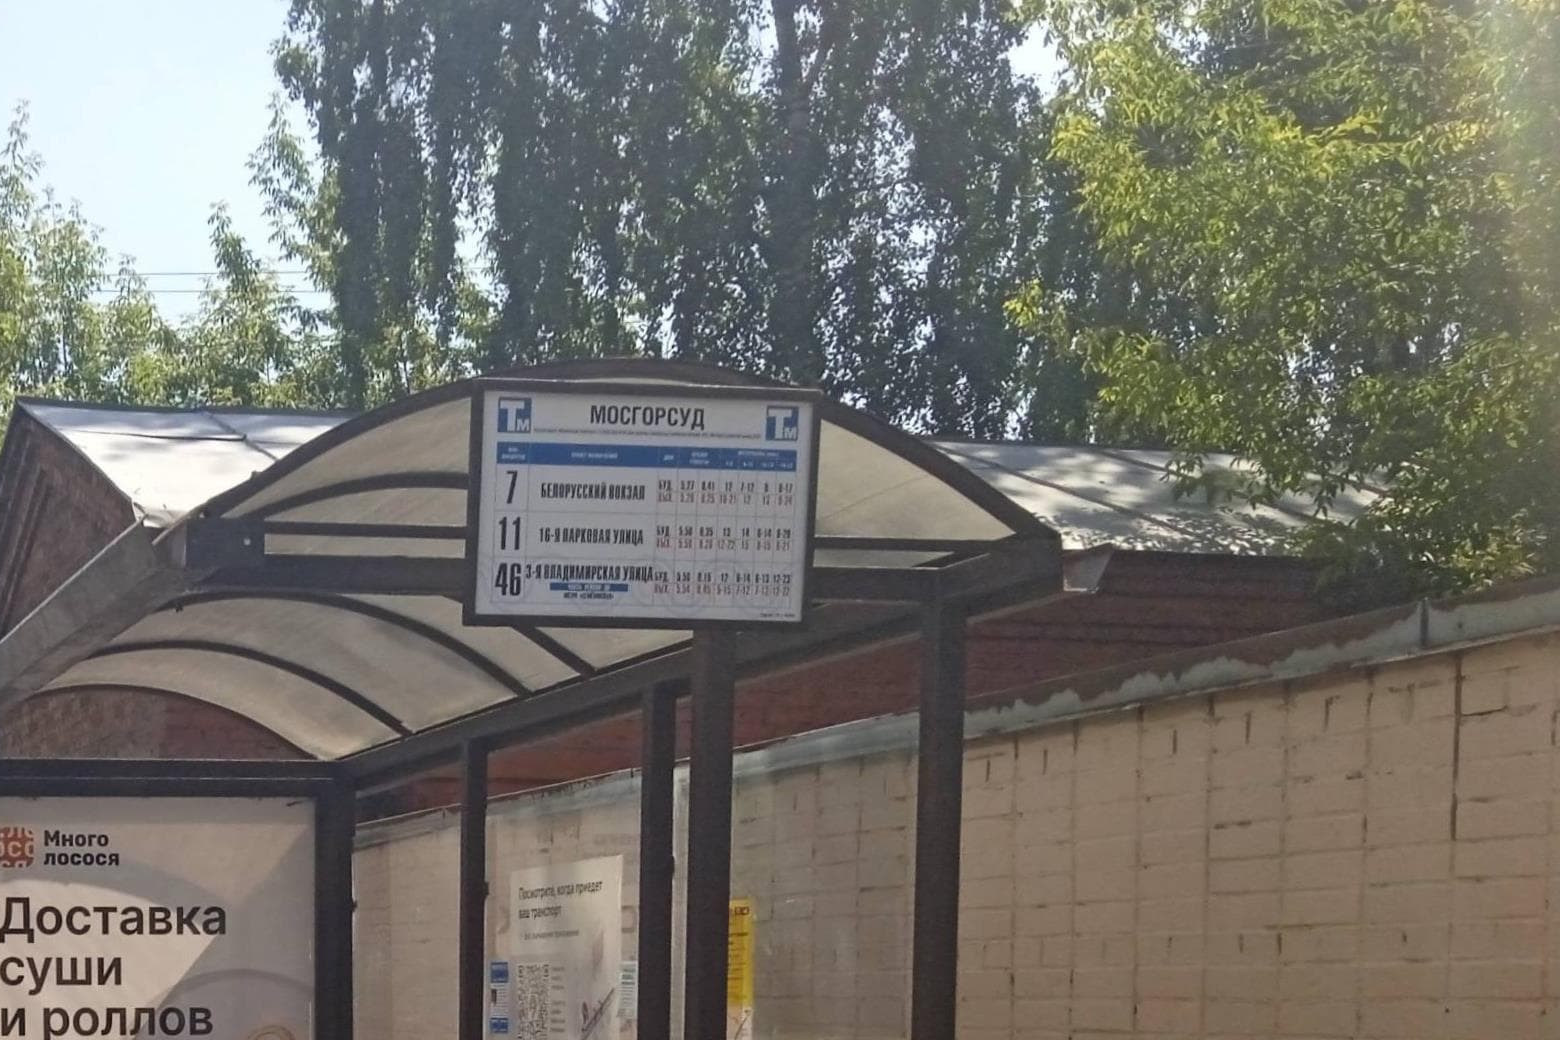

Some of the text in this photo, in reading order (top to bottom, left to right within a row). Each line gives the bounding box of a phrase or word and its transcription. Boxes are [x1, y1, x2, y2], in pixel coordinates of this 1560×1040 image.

[590, 405, 705, 430] МОСГОРСУД
[506, 470, 646, 504] 7 БЕЛОРУССКИЙ ВОКЗАЛ
[499, 516, 644, 550] 11 16-Я ПАРКОВАЯ УЛИЦА
[495, 562, 653, 596] 46 3-Я ВЛАДИМИРСКАЯ УЛИЦА
[43, 829, 109, 847] Много
[43, 850, 120, 867] лосося
[0, 956, 122, 996] суши
[1, 1007, 26, 1036] и
